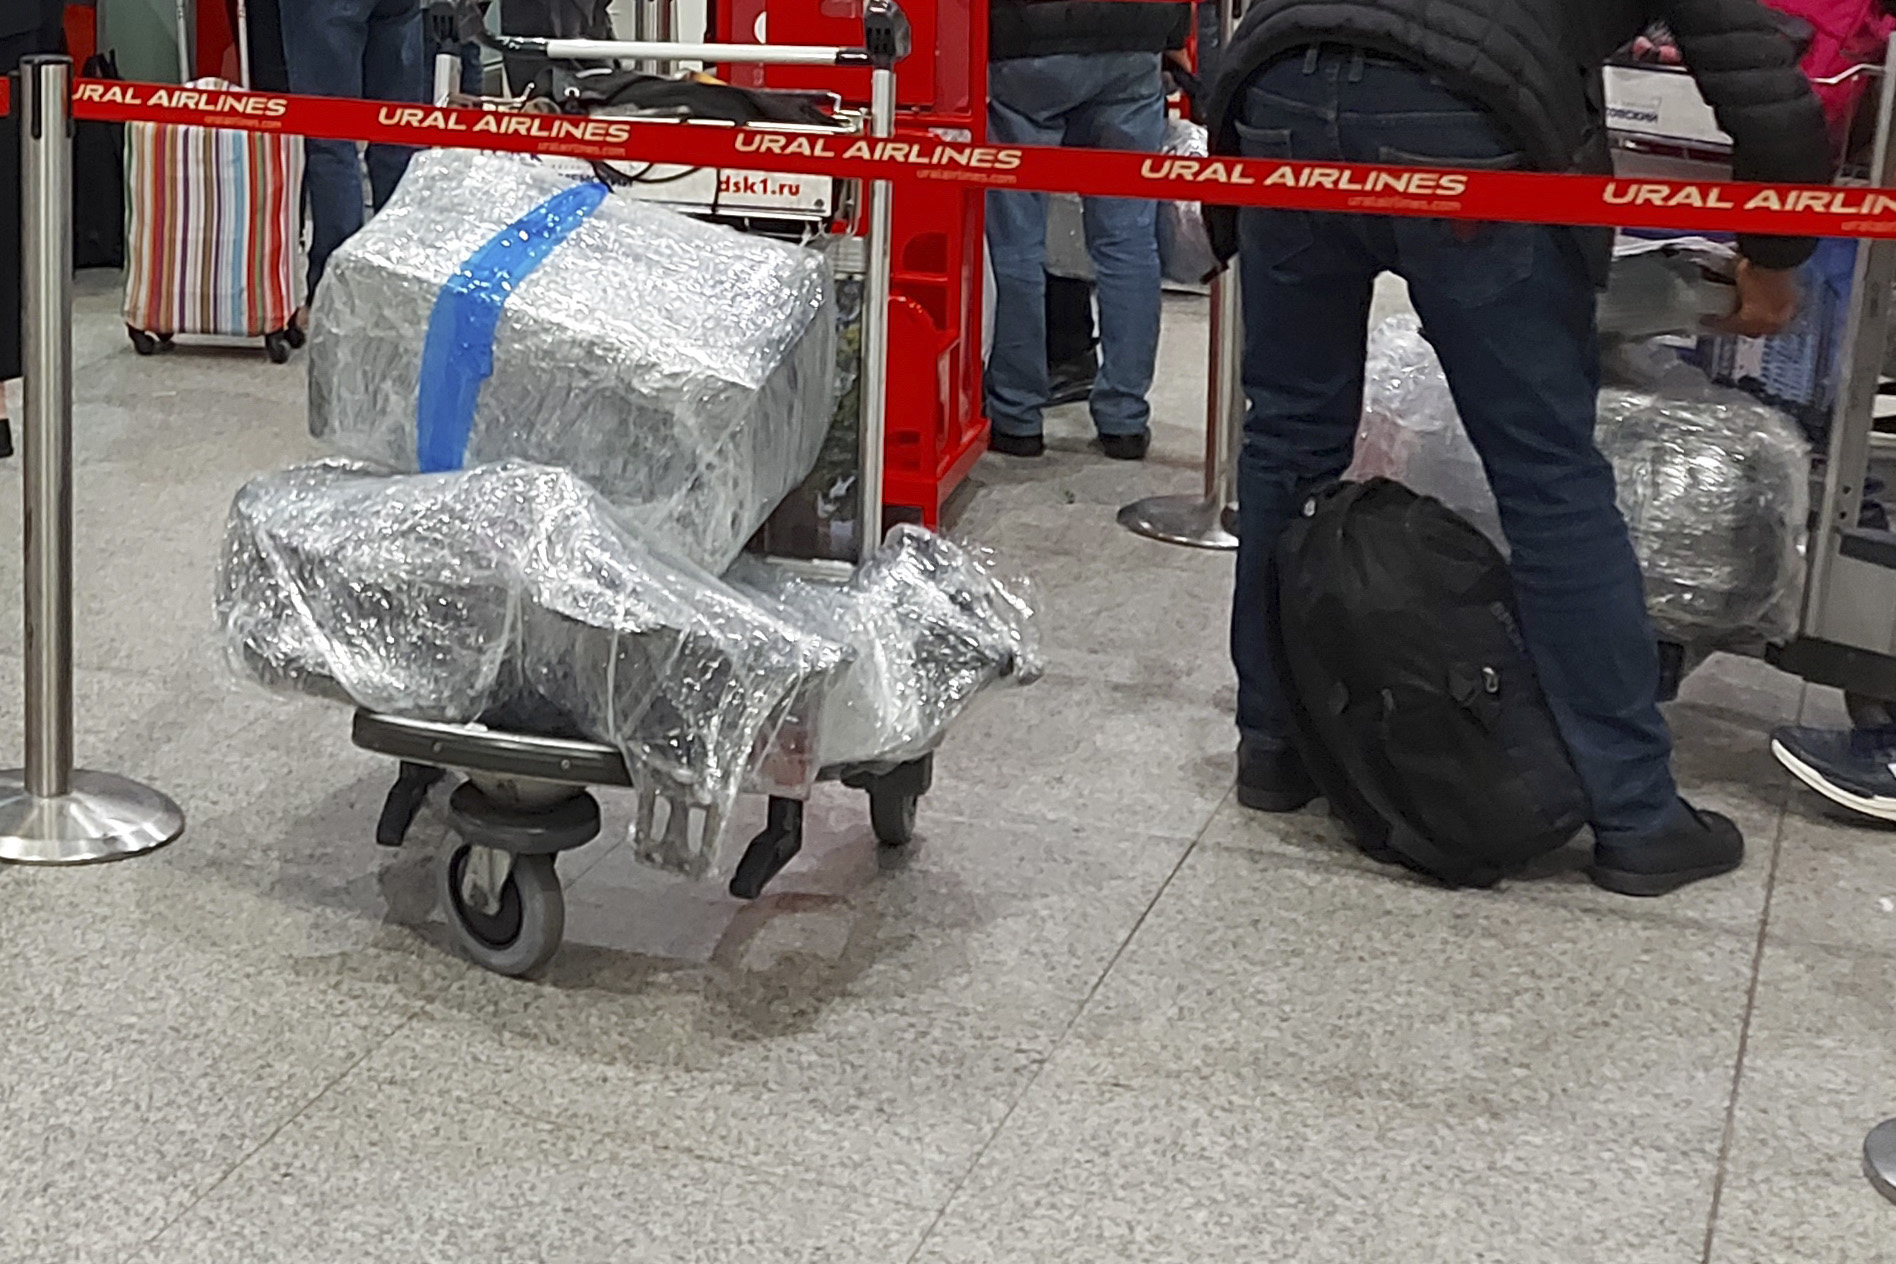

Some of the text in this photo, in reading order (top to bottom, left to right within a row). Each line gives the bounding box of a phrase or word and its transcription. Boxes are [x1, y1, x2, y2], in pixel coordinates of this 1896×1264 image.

[147, 89, 288, 116] AIRLINES
[377, 107, 631, 143] URAL AIRLINES
[734, 133, 1022, 169] URAL AIRLINES
[1140, 159, 1468, 196] URAL AIRLINES
[1603, 182, 1734, 208] URAL
